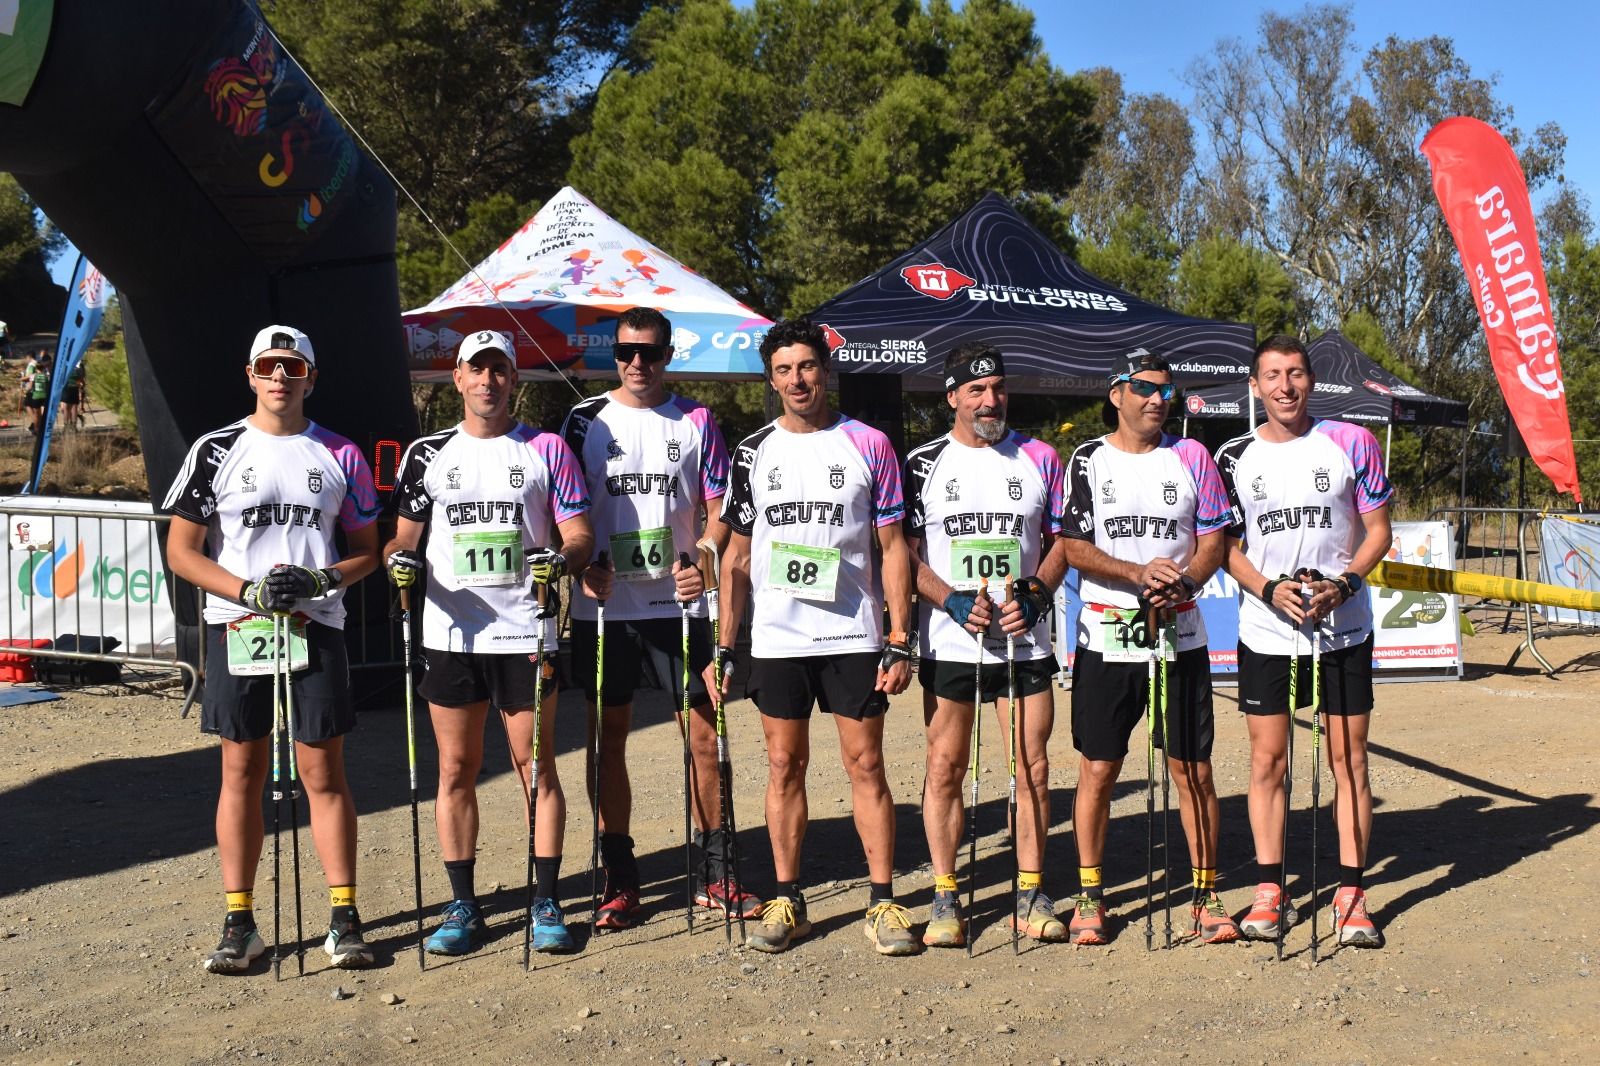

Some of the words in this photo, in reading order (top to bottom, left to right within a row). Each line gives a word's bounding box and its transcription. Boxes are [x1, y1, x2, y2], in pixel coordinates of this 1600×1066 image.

[556, 208, 582, 216] PARA
[527, 240, 576, 261] FEDME
[968, 288, 1128, 312] BULLONES
[982, 283, 1041, 295] INTEGRAL
[1039, 286, 1122, 304] SIERRA
[567, 334, 617, 347] FEDM
[880, 339, 926, 351] SIERRA
[838, 349, 927, 364] BULLONES
[1169, 361, 1250, 375] w.clubanyera.es
[1201, 406, 1240, 414] BULLONES
[606, 473, 679, 498] CEUTA
[241, 503, 321, 531] CEUTA
[446, 501, 525, 526] CEUTA
[765, 501, 845, 527] CEUTA
[943, 512, 1025, 537] CEUTA
[1257, 506, 1332, 536] CEUTA
[1103, 515, 1178, 540] CEUTA
[465, 546, 512, 572] 111
[631, 543, 661, 568] 66
[962, 554, 1010, 579] 105
[786, 560, 819, 586] 88
[251, 636, 285, 660] 22
[1118, 626, 1159, 649] 10
[1372, 646, 1454, 658] UNNING-INCLUSIÓN
